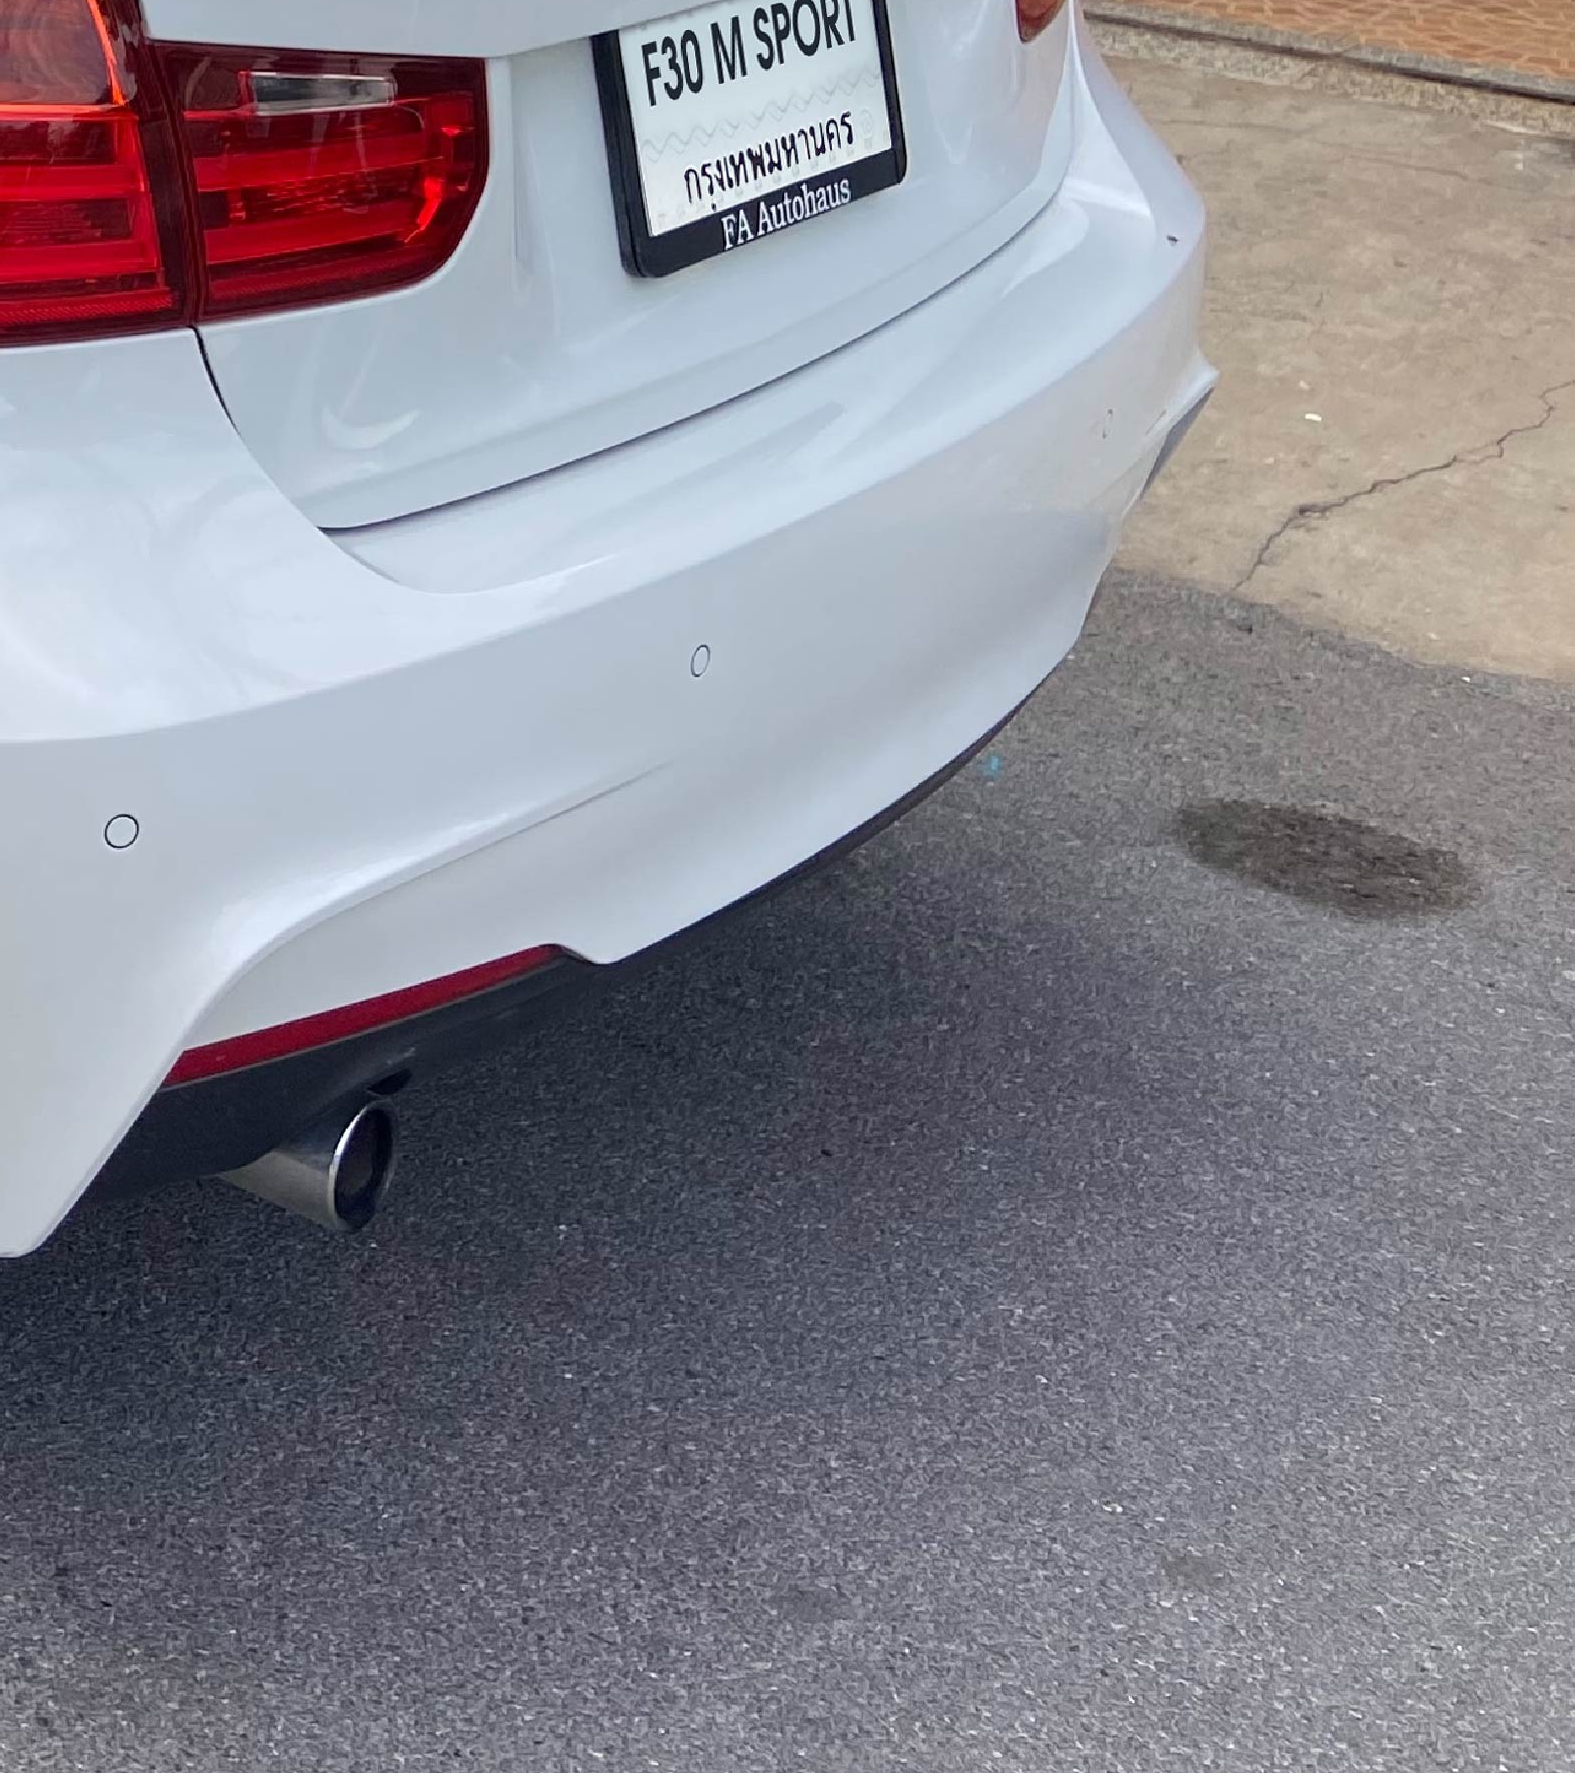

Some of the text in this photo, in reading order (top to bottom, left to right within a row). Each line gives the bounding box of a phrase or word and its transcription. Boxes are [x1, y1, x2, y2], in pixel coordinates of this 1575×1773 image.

[641, 29, 704, 107] F30
[710, 15, 749, 85] M
[683, 111, 855, 212] กรุงเทพมหานคร
[720, 179, 852, 250] FA Autohaus
